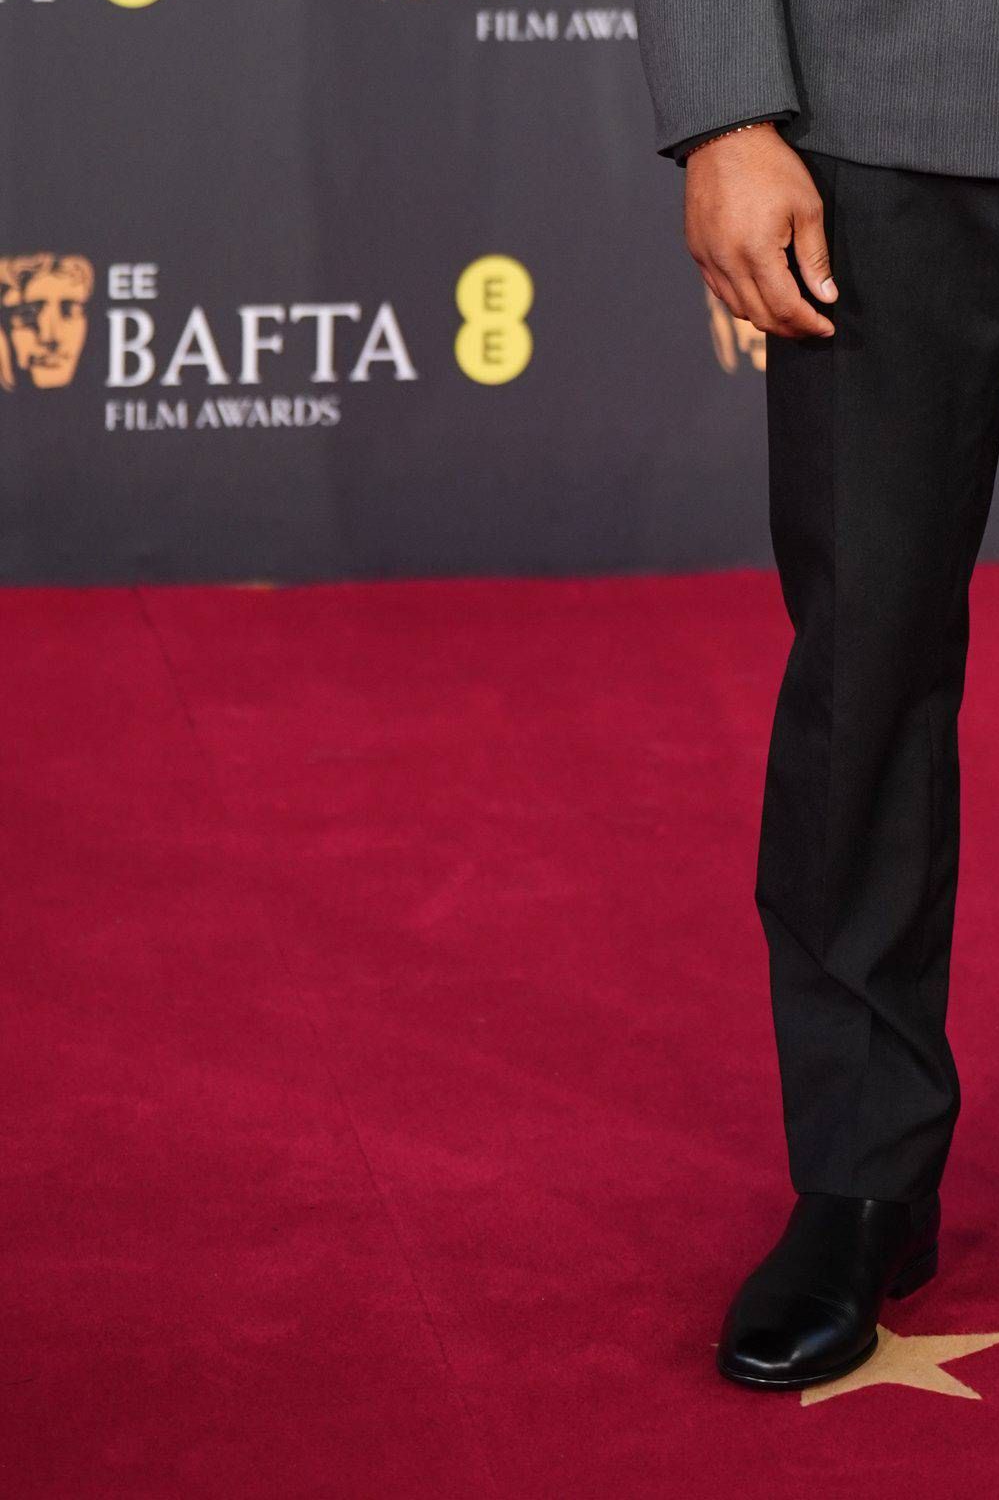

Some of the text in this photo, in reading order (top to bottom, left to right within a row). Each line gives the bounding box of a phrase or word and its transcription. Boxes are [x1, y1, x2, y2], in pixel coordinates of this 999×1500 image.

[476, 11, 558, 41] FILM
[108, 264, 157, 299] EE
[107, 304, 416, 387] BAFTA
[105, 397, 339, 430] FILM AWARDS
